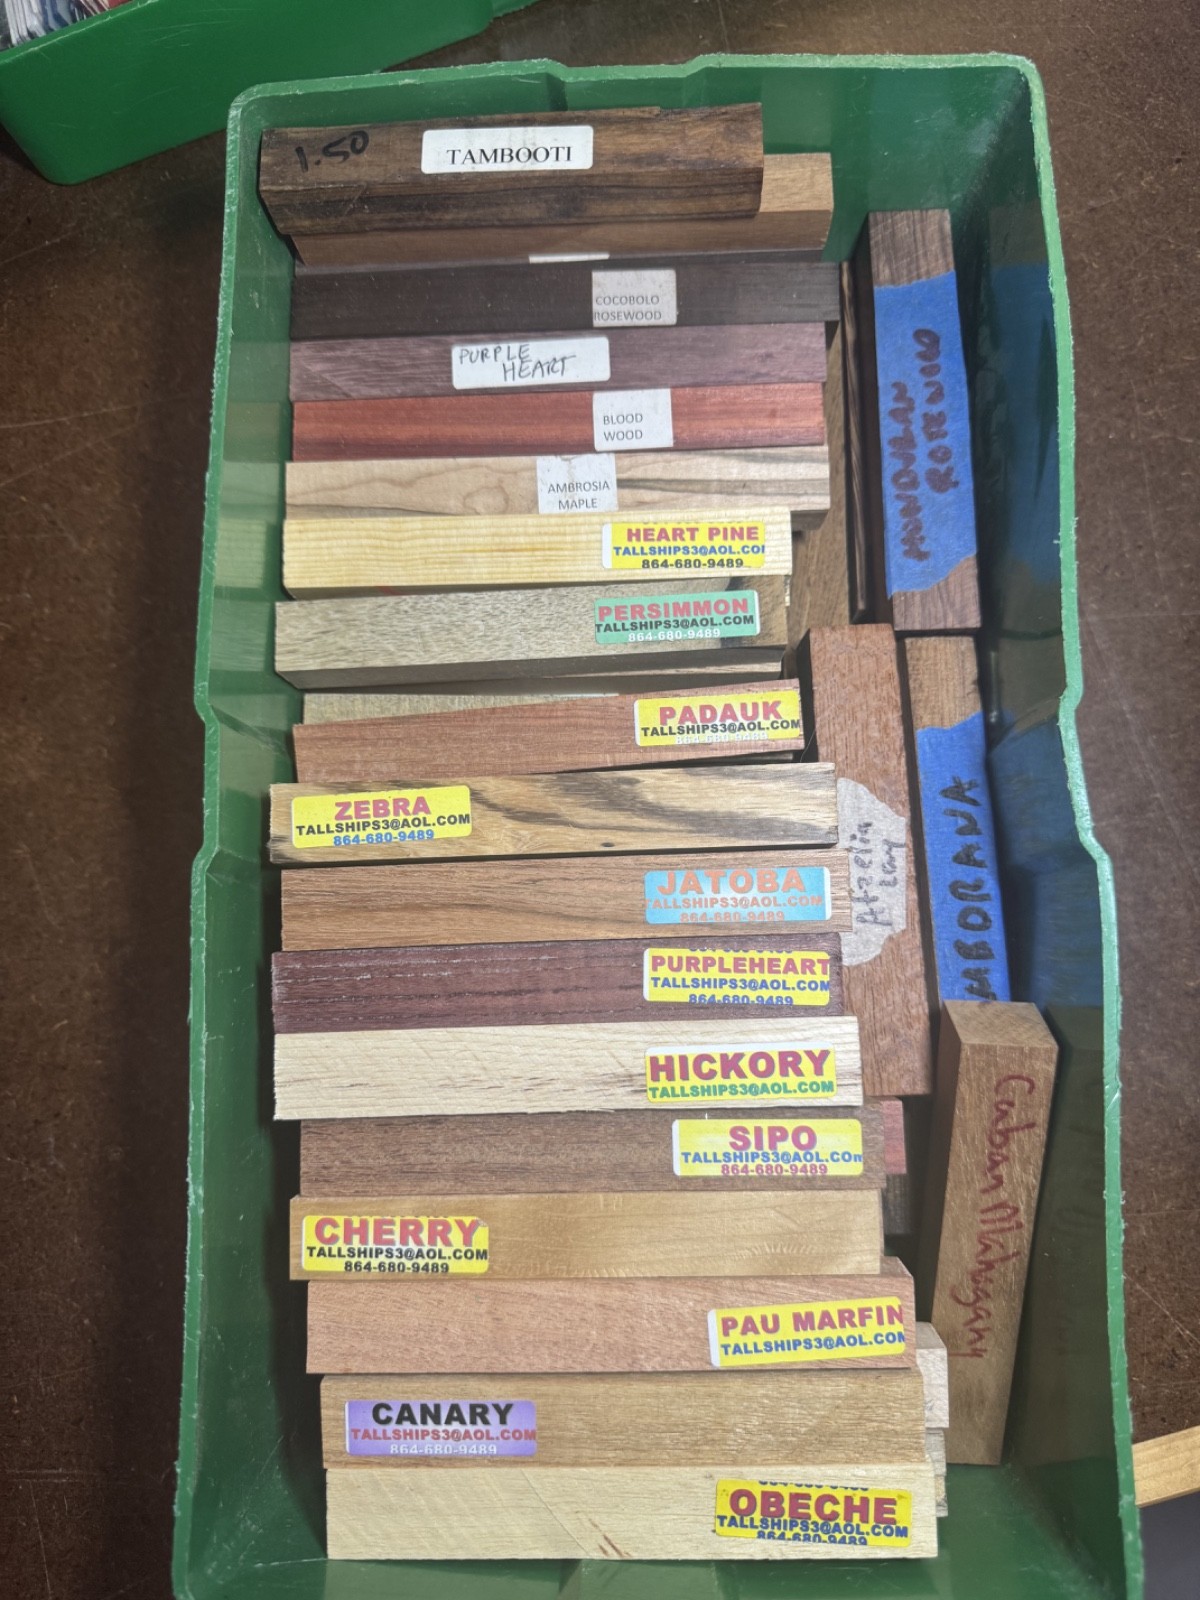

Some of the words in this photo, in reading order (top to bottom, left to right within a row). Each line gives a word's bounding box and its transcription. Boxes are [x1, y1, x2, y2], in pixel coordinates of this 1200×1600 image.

[295, 129, 370, 173] 1.50
[446, 145, 572, 166] TAMBOOTI
[595, 295, 660, 306] COCOBOLO
[593, 310, 662, 321] ROSEWOOD
[459, 343, 531, 365] PURPLE
[502, 354, 577, 382] HEART
[602, 412, 644, 426] BLOOD
[603, 429, 643, 442] WOOD
[547, 480, 611, 494] AMBROSIA
[558, 498, 598, 510] MAPLE
[626, 527, 700, 543] HEART
[707, 526, 759, 541] PINE
[641, 558, 744, 569] 864-680-9489
[598, 598, 749, 622] PERSIMMON
[595, 615, 755, 633] TALLSHIPS3@AOL.COM
[628, 628, 721, 643] 864-680-9489
[659, 700, 783, 726] PADAUK
[641, 719, 801, 737] TALLSHIPS3@AOL.COM
[334, 796, 431, 821] ZEBRA
[296, 813, 471, 836] TALLSHIPS3@AOL.COM
[333, 829, 435, 847] 864-680-9489
[657, 868, 806, 895] JATOBA
[651, 955, 831, 975] PURPLEHEART
[688, 994, 794, 1006] 864-680-9489
[650, 1049, 831, 1082] HICKORY
[649, 1080, 834, 1099] TALLSHIPS3@AOL.COM
[728, 1124, 818, 1151] SIPO
[980, 1073, 1036, 1195] Cuban
[721, 1163, 828, 1175] 864-680-9489
[314, 1216, 480, 1247] CHERRY
[306, 1246, 488, 1261] TALLSHIPS3@AOL.COM
[344, 1261, 450, 1273] 864-680-9489
[948, 1200, 1025, 1358] Mahogany
[721, 1313, 780, 1337] PAU
[792, 1304, 904, 1333] MARFIN
[372, 1402, 514, 1426] CANARY
[350, 1428, 537, 1442] TALLSHIPS3@AOL.COM
[390, 1444, 498, 1455] 864-680-9489
[729, 1488, 897, 1525] OBECHE
[716, 1514, 909, 1538] TALLSHIPS3@AOL.COM
